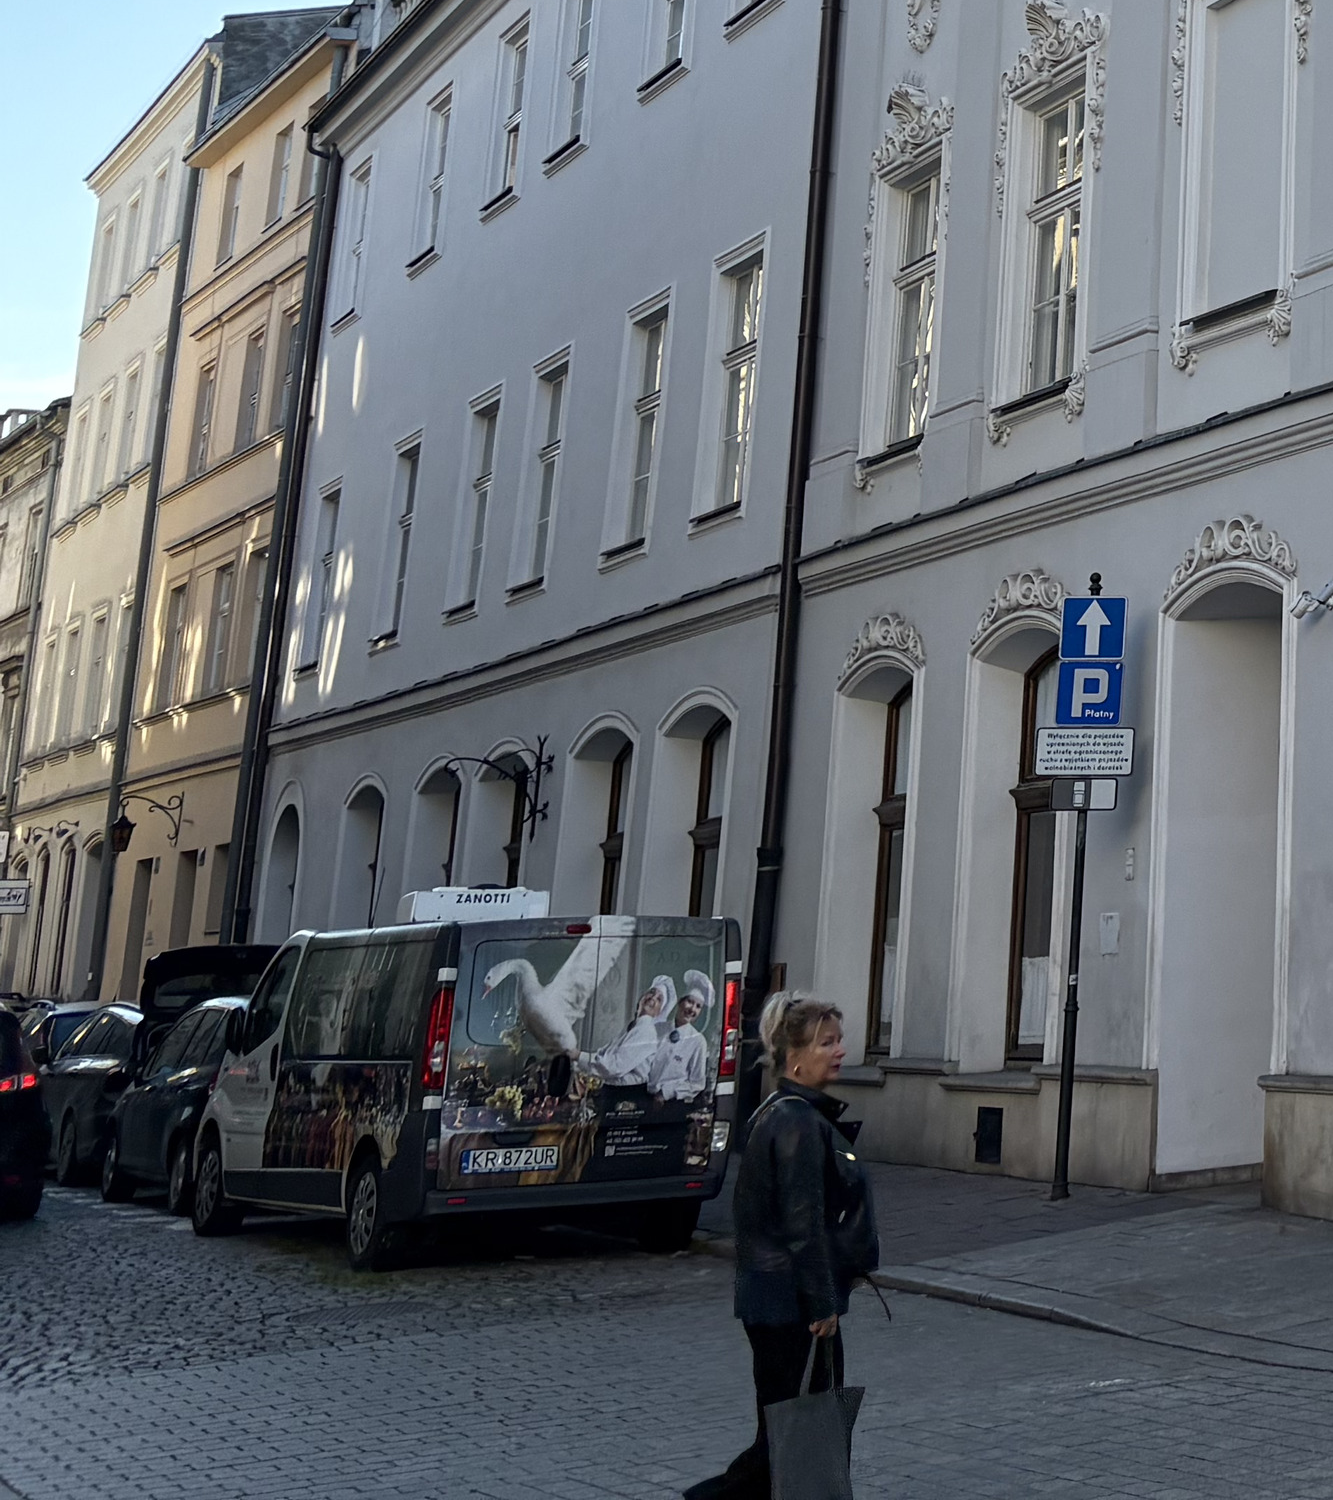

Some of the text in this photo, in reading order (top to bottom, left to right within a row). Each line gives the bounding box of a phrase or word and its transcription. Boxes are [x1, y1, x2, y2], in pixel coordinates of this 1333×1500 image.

[1071, 668, 1109, 718] P
[1084, 709, 1114, 719] Płatny
[456, 893, 511, 904] ZANOTTI
[472, 1148, 555, 1169] KR 872UR
